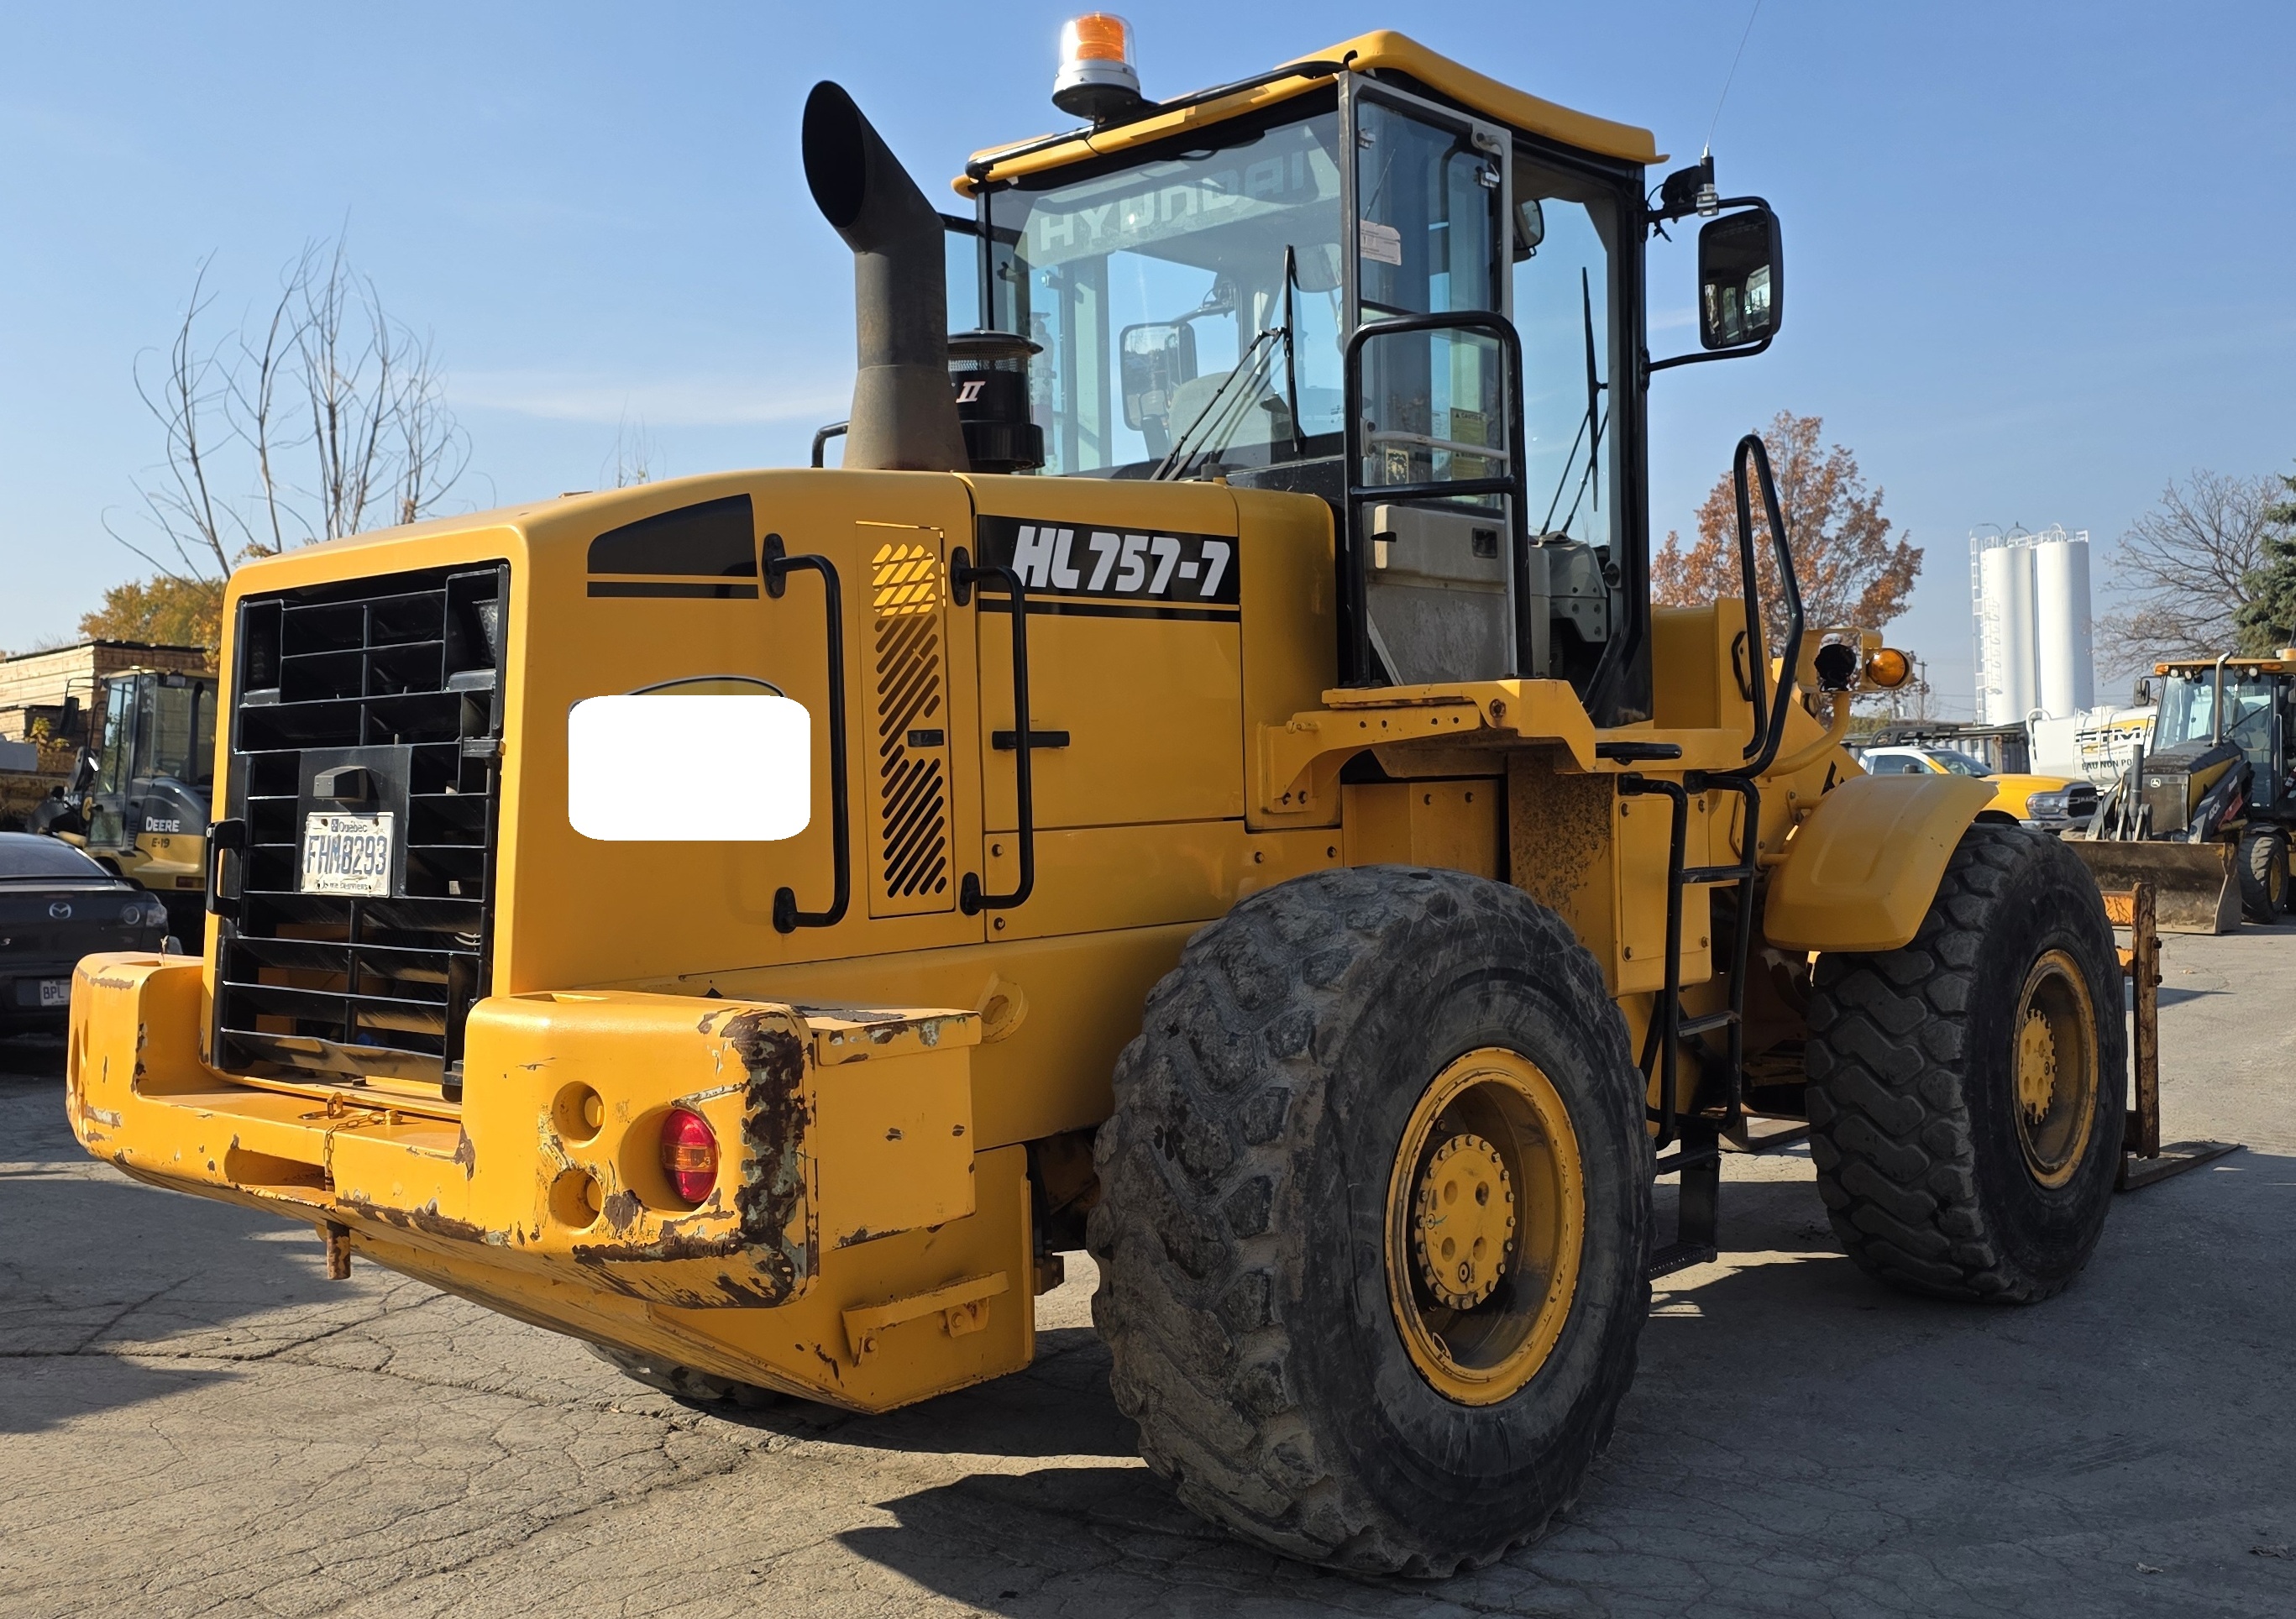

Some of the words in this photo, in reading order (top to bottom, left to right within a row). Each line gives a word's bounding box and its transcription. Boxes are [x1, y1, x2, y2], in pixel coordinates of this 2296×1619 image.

[1040, 149, 1306, 253] HYUNDAI
[1011, 525, 1080, 589] HL
[1088, 531, 1231, 597] 757-7
[145, 816, 181, 832] DEERE
